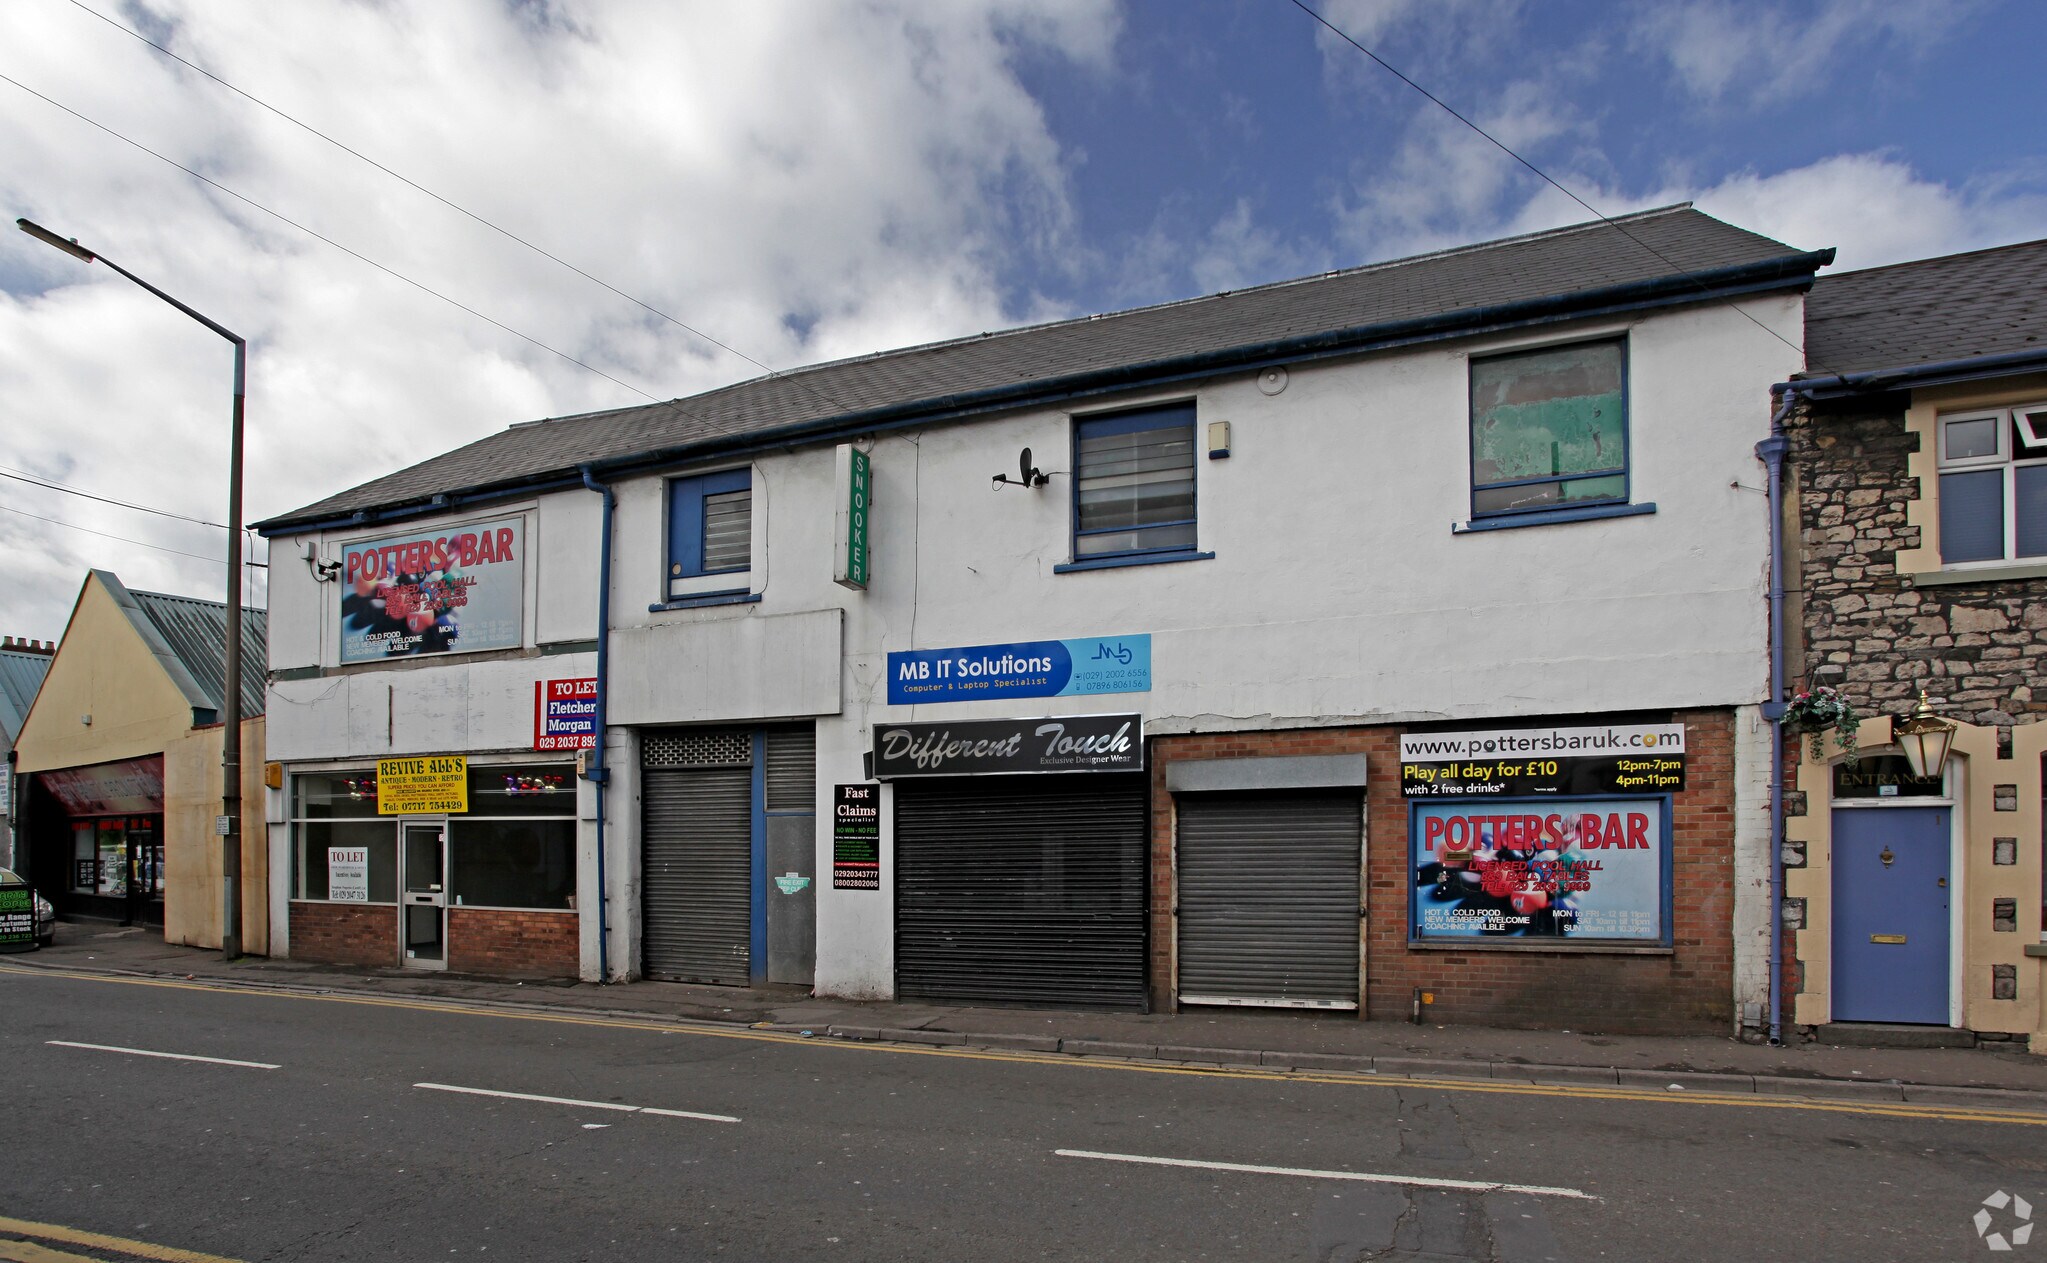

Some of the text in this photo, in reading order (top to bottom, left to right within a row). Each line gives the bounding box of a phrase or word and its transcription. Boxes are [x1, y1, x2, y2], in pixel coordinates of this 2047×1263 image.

[854, 456, 863, 581] SNOOKER
[347, 528, 514, 584] POTTERS BAR
[423, 580, 448, 591] POOL
[451, 576, 477, 587] HALL
[439, 625, 454, 633] MON
[391, 635, 422, 645] WELCOME
[899, 654, 1052, 681] MB IT Solutions
[1083, 668, 1147, 681] (029) 2002 6556
[556, 681, 597, 695] TO LET
[903, 684, 943, 693] Computer
[958, 681, 989, 690] Laptop
[994, 677, 1047, 687] Specialist
[1086, 680, 1143, 690] 07896 806156
[549, 701, 596, 714] Fletcher
[548, 719, 591, 733] Morgan
[539, 737, 555, 749] 029
[557, 736, 579, 748] 2037
[882, 721, 1131, 769] Different Touch
[1405, 729, 1680, 758] www.pottersbaruk.com
[1040, 754, 1131, 765] Exclusive Designer Wear
[1616, 759, 1681, 772] 12pm-7pm
[380, 758, 463, 776] REVIVE ALL'S
[1404, 760, 1558, 782] Play all day for £10
[381, 774, 463, 784] ANTIQUE MODERN RETRO
[1616, 774, 1679, 787] 4pm-11pm
[844, 787, 869, 799] Fast
[1405, 784, 1428, 794] with
[1431, 784, 1438, 794] 2
[1441, 783, 1463, 793] free
[383, 800, 462, 811] Tel: 07717 754429
[837, 804, 877, 816] Claims
[1424, 812, 1650, 851] POTTERS BAR
[330, 851, 365, 862] TO LET
[1532, 861, 1566, 871] POOL
[1570, 860, 1603, 871] HALL
[834, 870, 878, 878] 02920343777
[1506, 871, 1539, 881] BALL
[1543, 871, 1590, 881] TABLES
[834, 879, 878, 888] 08002802006
[1508, 882, 1529, 891] 029
[1488, 916, 1530, 924] WELCOME
